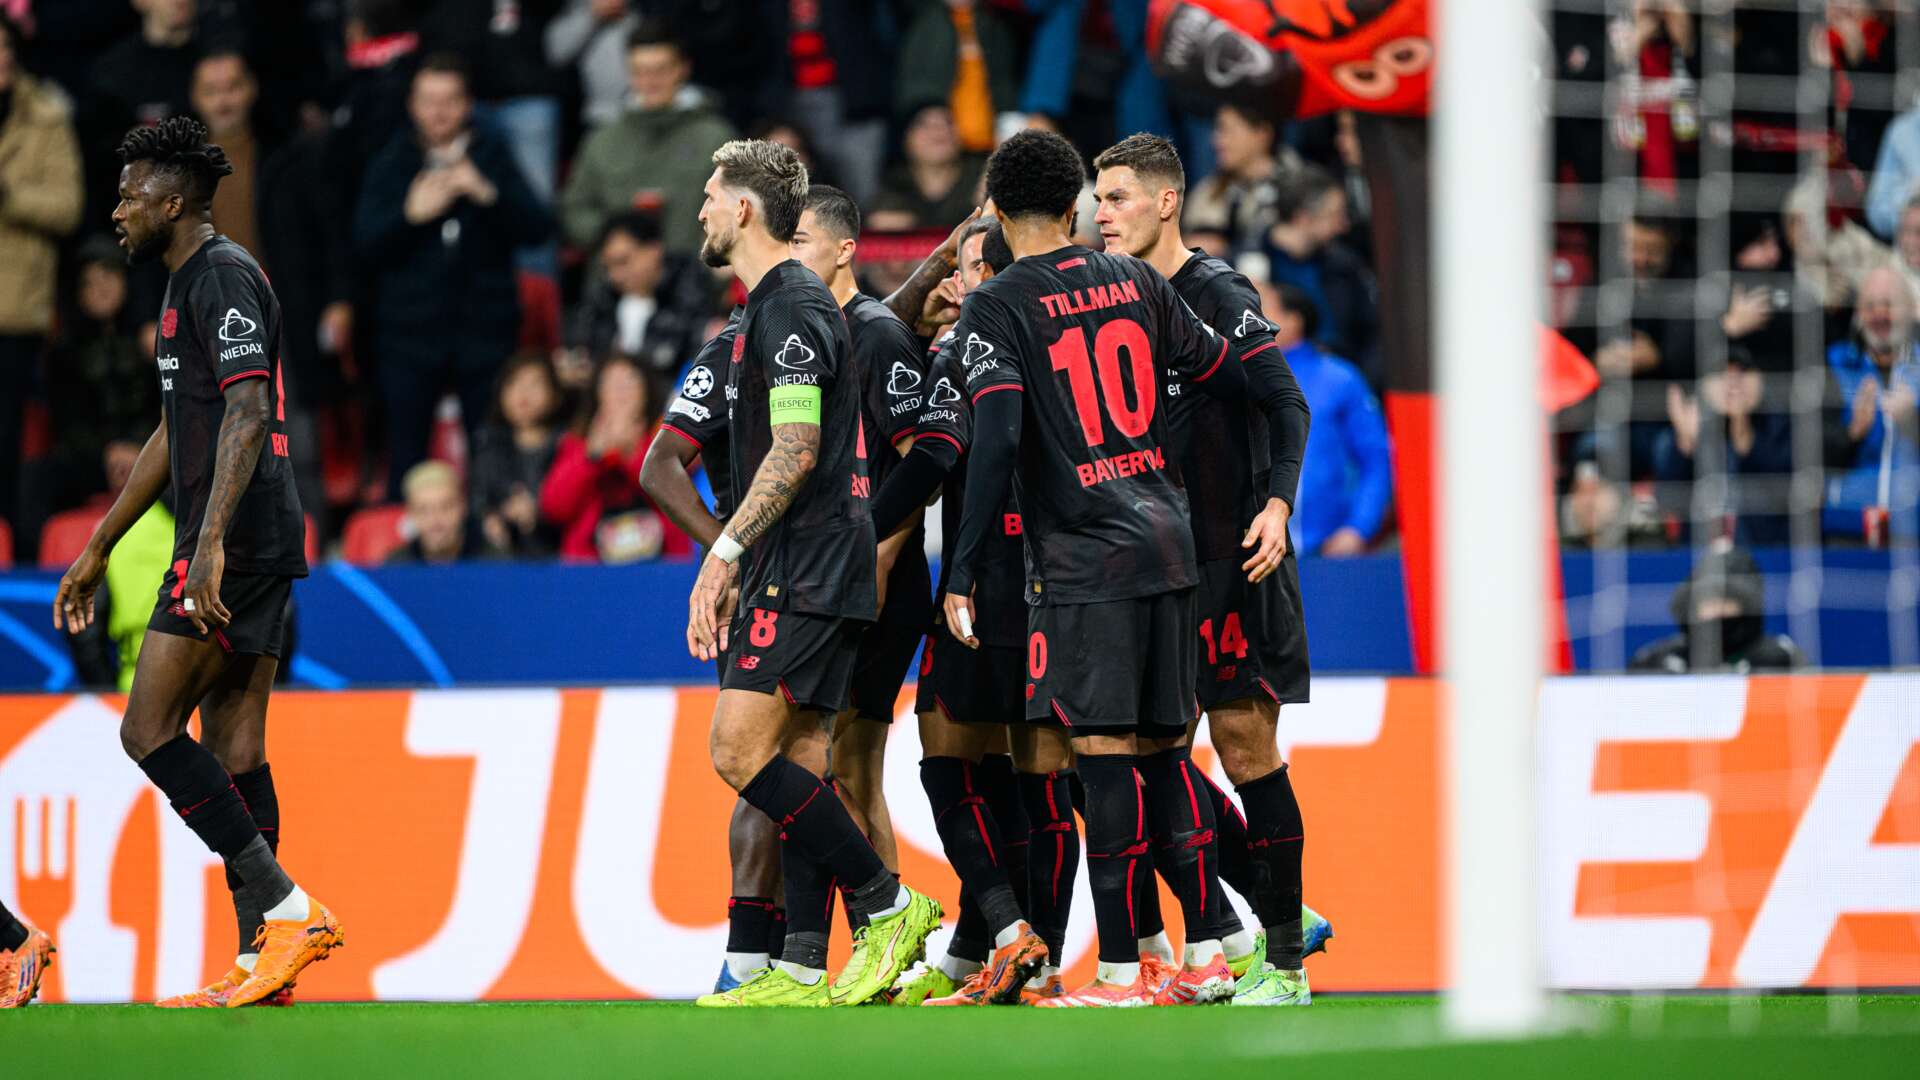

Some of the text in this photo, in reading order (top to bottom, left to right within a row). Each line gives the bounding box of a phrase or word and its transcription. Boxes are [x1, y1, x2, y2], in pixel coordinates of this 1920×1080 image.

[1040, 279, 1141, 318] TILLMAN
[219, 343, 264, 362] NIEDAX
[774, 373, 819, 388] NIEDAX
[966, 358, 1000, 385] NIEDAX
[1047, 318, 1157, 447] 10
[777, 400, 813, 409] RESPECT
[918, 410, 960, 424] NIEDAX
[749, 607, 779, 648] 8
[1199, 612, 1248, 665] 14
